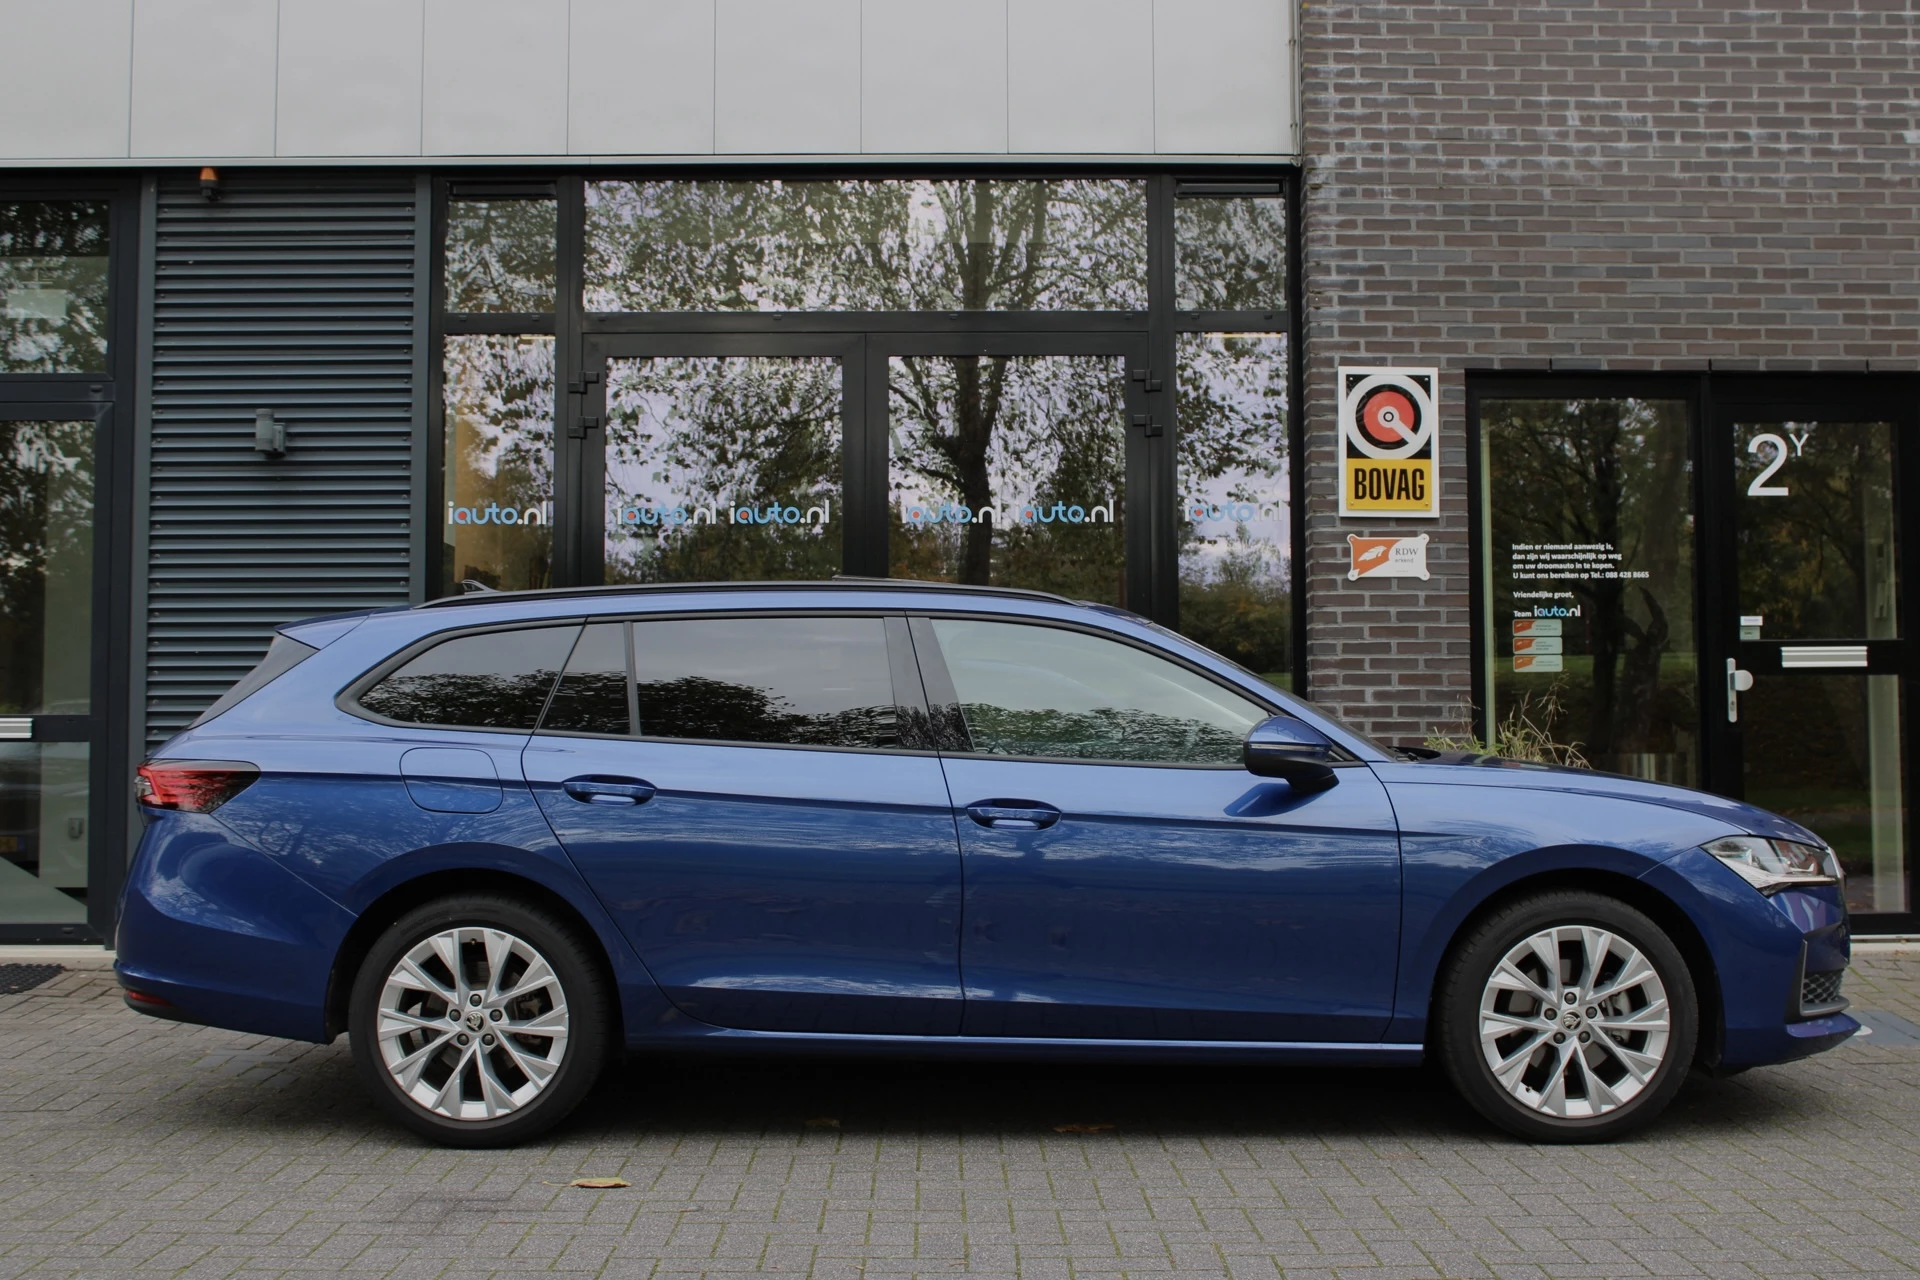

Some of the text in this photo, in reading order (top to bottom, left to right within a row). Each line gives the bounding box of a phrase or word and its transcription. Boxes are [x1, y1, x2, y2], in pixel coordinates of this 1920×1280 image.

[1353, 467, 1425, 501] BOVAG
[447, 500, 548, 525] iauto.nl
[616, 500, 717, 525] iauto.nl
[729, 500, 830, 524] iauto.nl
[901, 499, 1001, 524] iauto.nl
[1014, 499, 1114, 523] iauto.nl
[1395, 547, 1418, 556] RDW
[1574, 543, 1605, 551] aanwezig
[1606, 543, 1614, 551] is,
[1526, 553, 1539, 561] zijn
[1539, 553, 1550, 561] wij
[1551, 553, 1597, 561] waarschijnlijk
[1597, 553, 1607, 561] op
[1608, 553, 1622, 561] weg
[1537, 562, 1575, 570] droomauto
[1592, 562, 1615, 570] kopen.
[1550, 571, 1579, 579] bereiken
[1580, 572, 1589, 580] op
[1605, 571, 1618, 579] 088
[1619, 571, 1632, 579] 428
[1513, 591, 1574, 599] Vriendelijke groet,
[1533, 604, 1581, 617] iauto.nl
